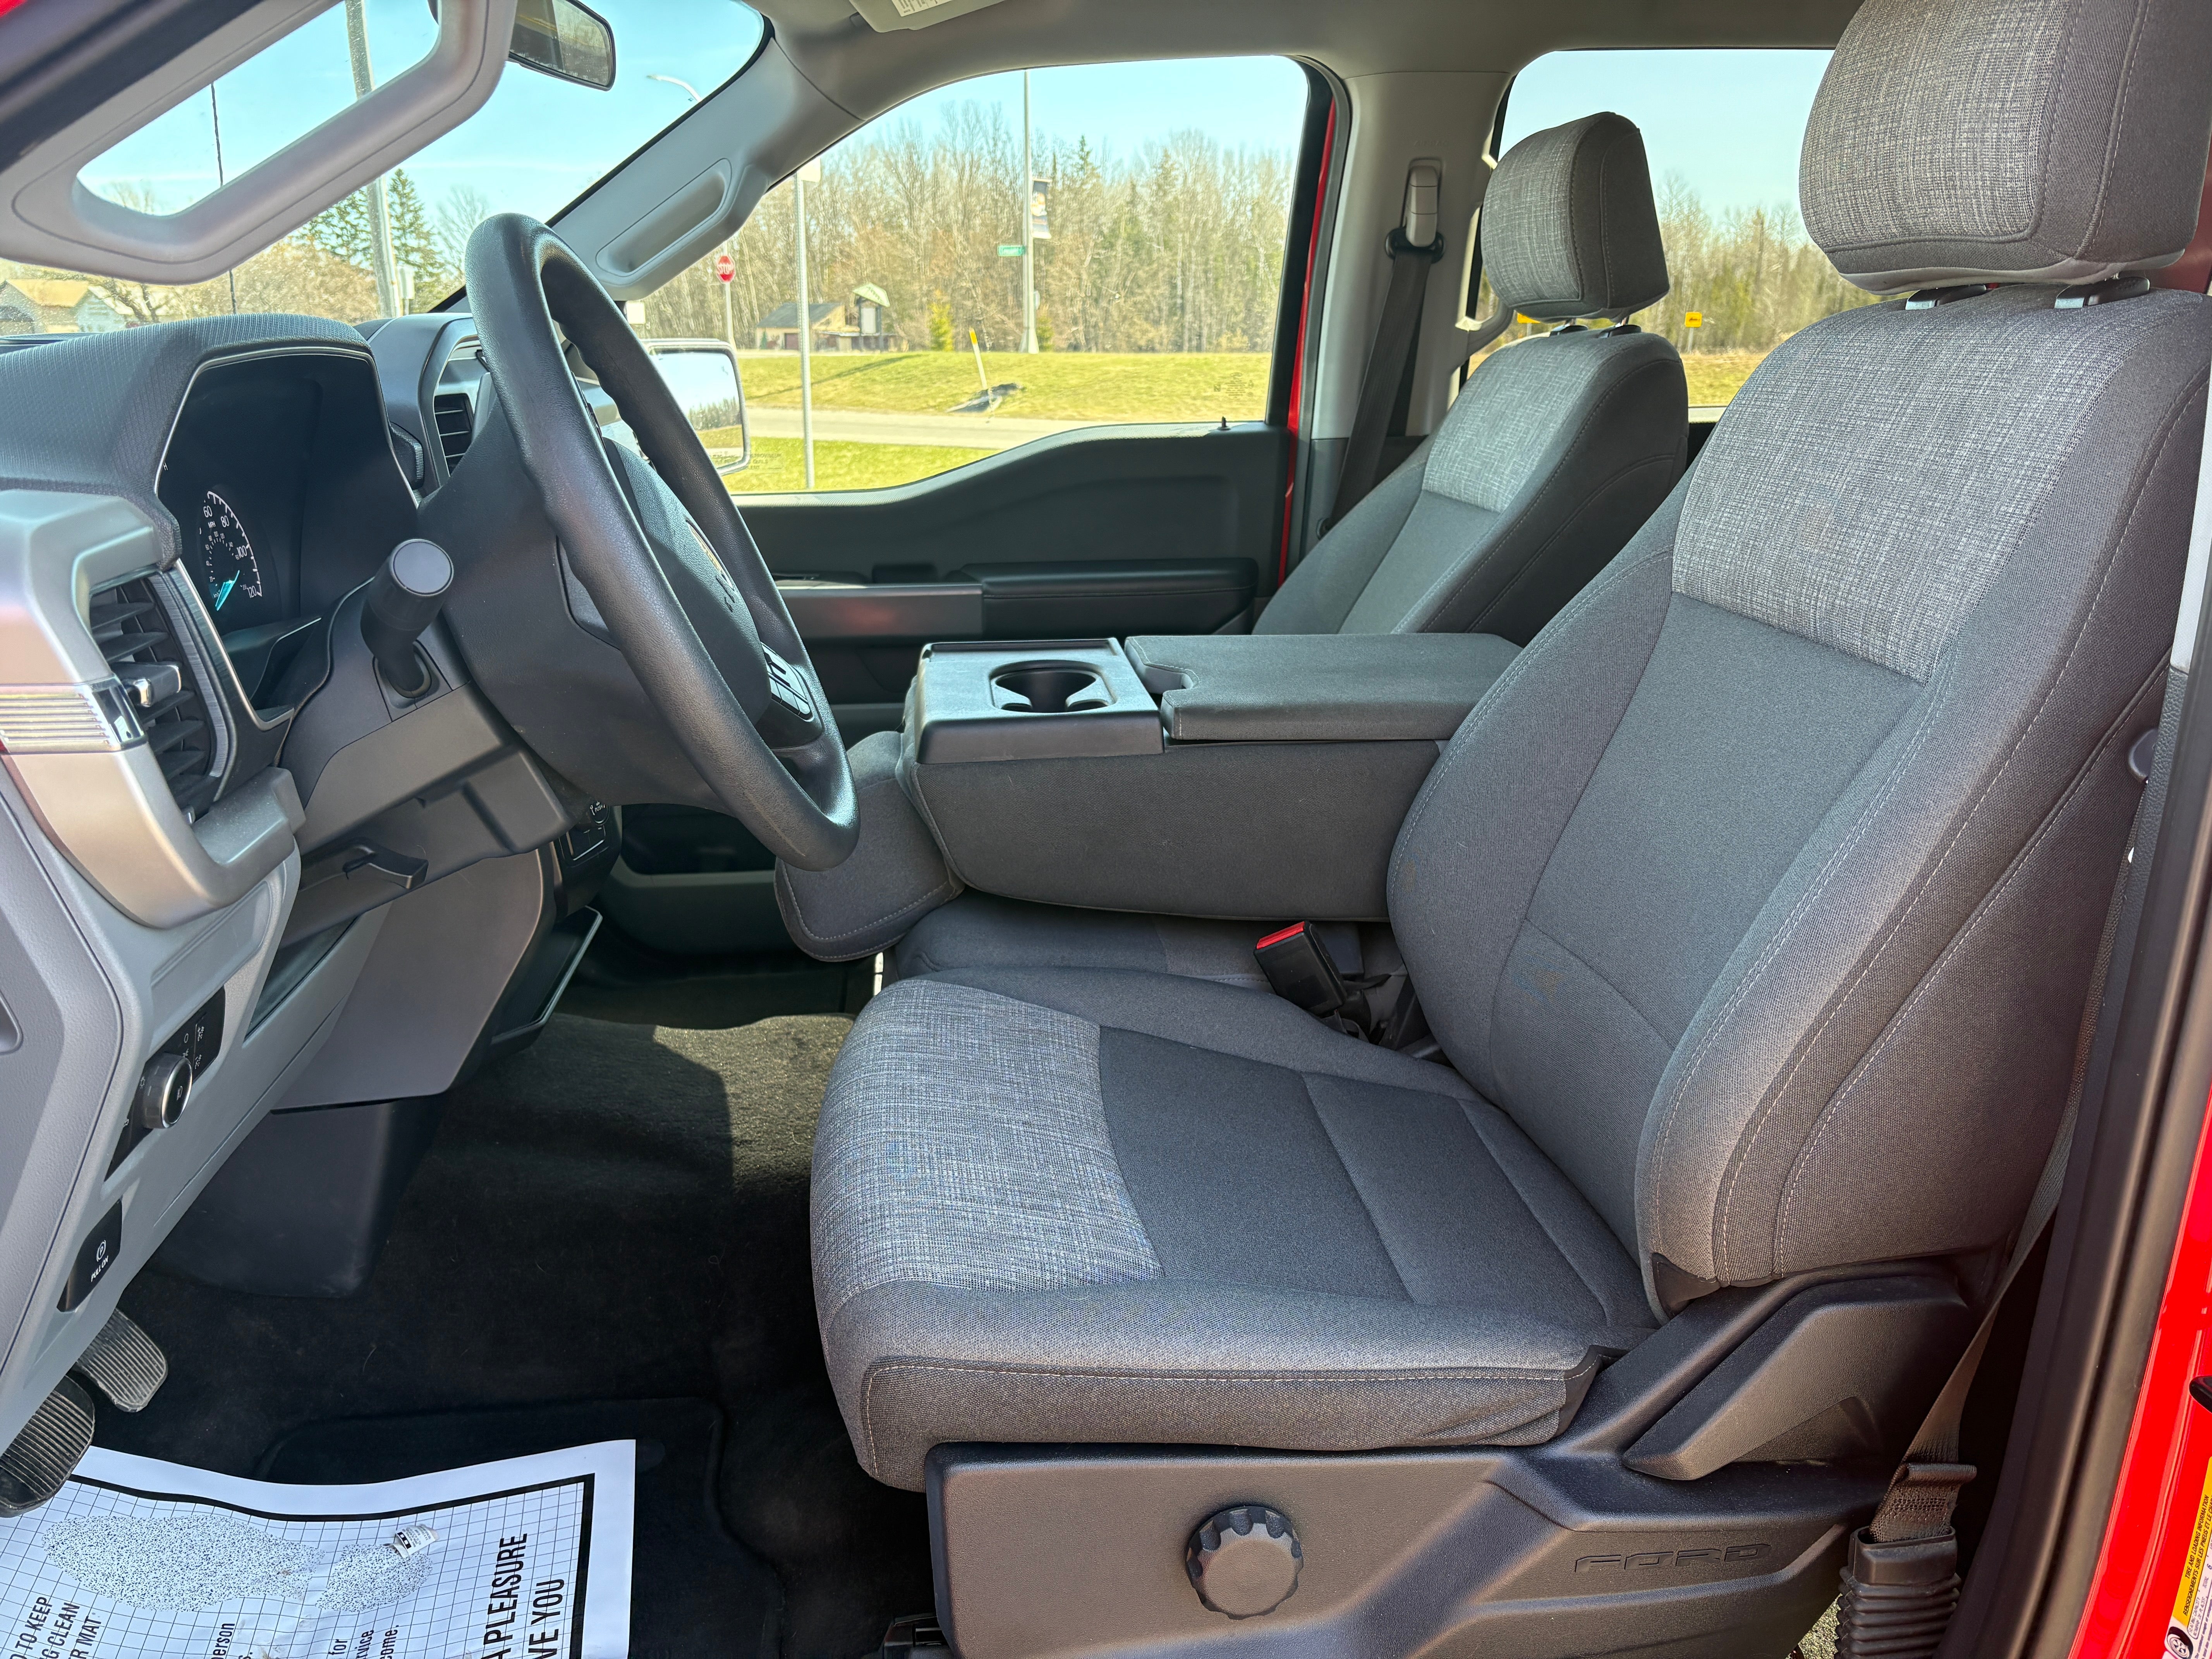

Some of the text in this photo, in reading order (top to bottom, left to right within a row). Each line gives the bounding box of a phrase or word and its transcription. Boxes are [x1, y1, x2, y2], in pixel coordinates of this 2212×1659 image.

[717, 263, 734, 274] STOP
[203, 505, 213, 518] 60
[220, 515, 230, 527] 80
[237, 545, 247, 558] 100
[247, 586, 257, 598] 120
[91, 1255, 109, 1283] PULL ON
[2191, 1531, 2201, 1555] LOADING
[2197, 1494, 2209, 1531] INFORMATION
[1575, 1543, 1771, 1572] FORD
[483, 1534, 527, 1645] PLEASURE
[531, 1579, 564, 1625] YOU
[25, 1597, 52, 1631] KEEP
[48, 1602, 80, 1646] CLEAN
[15, 1633, 37, 1650] TO
[76, 1616, 101, 1646] MAT
[211, 1623, 235, 1659] erson
[356, 1630, 374, 1659] rvice
[328, 1639, 347, 1655] for
